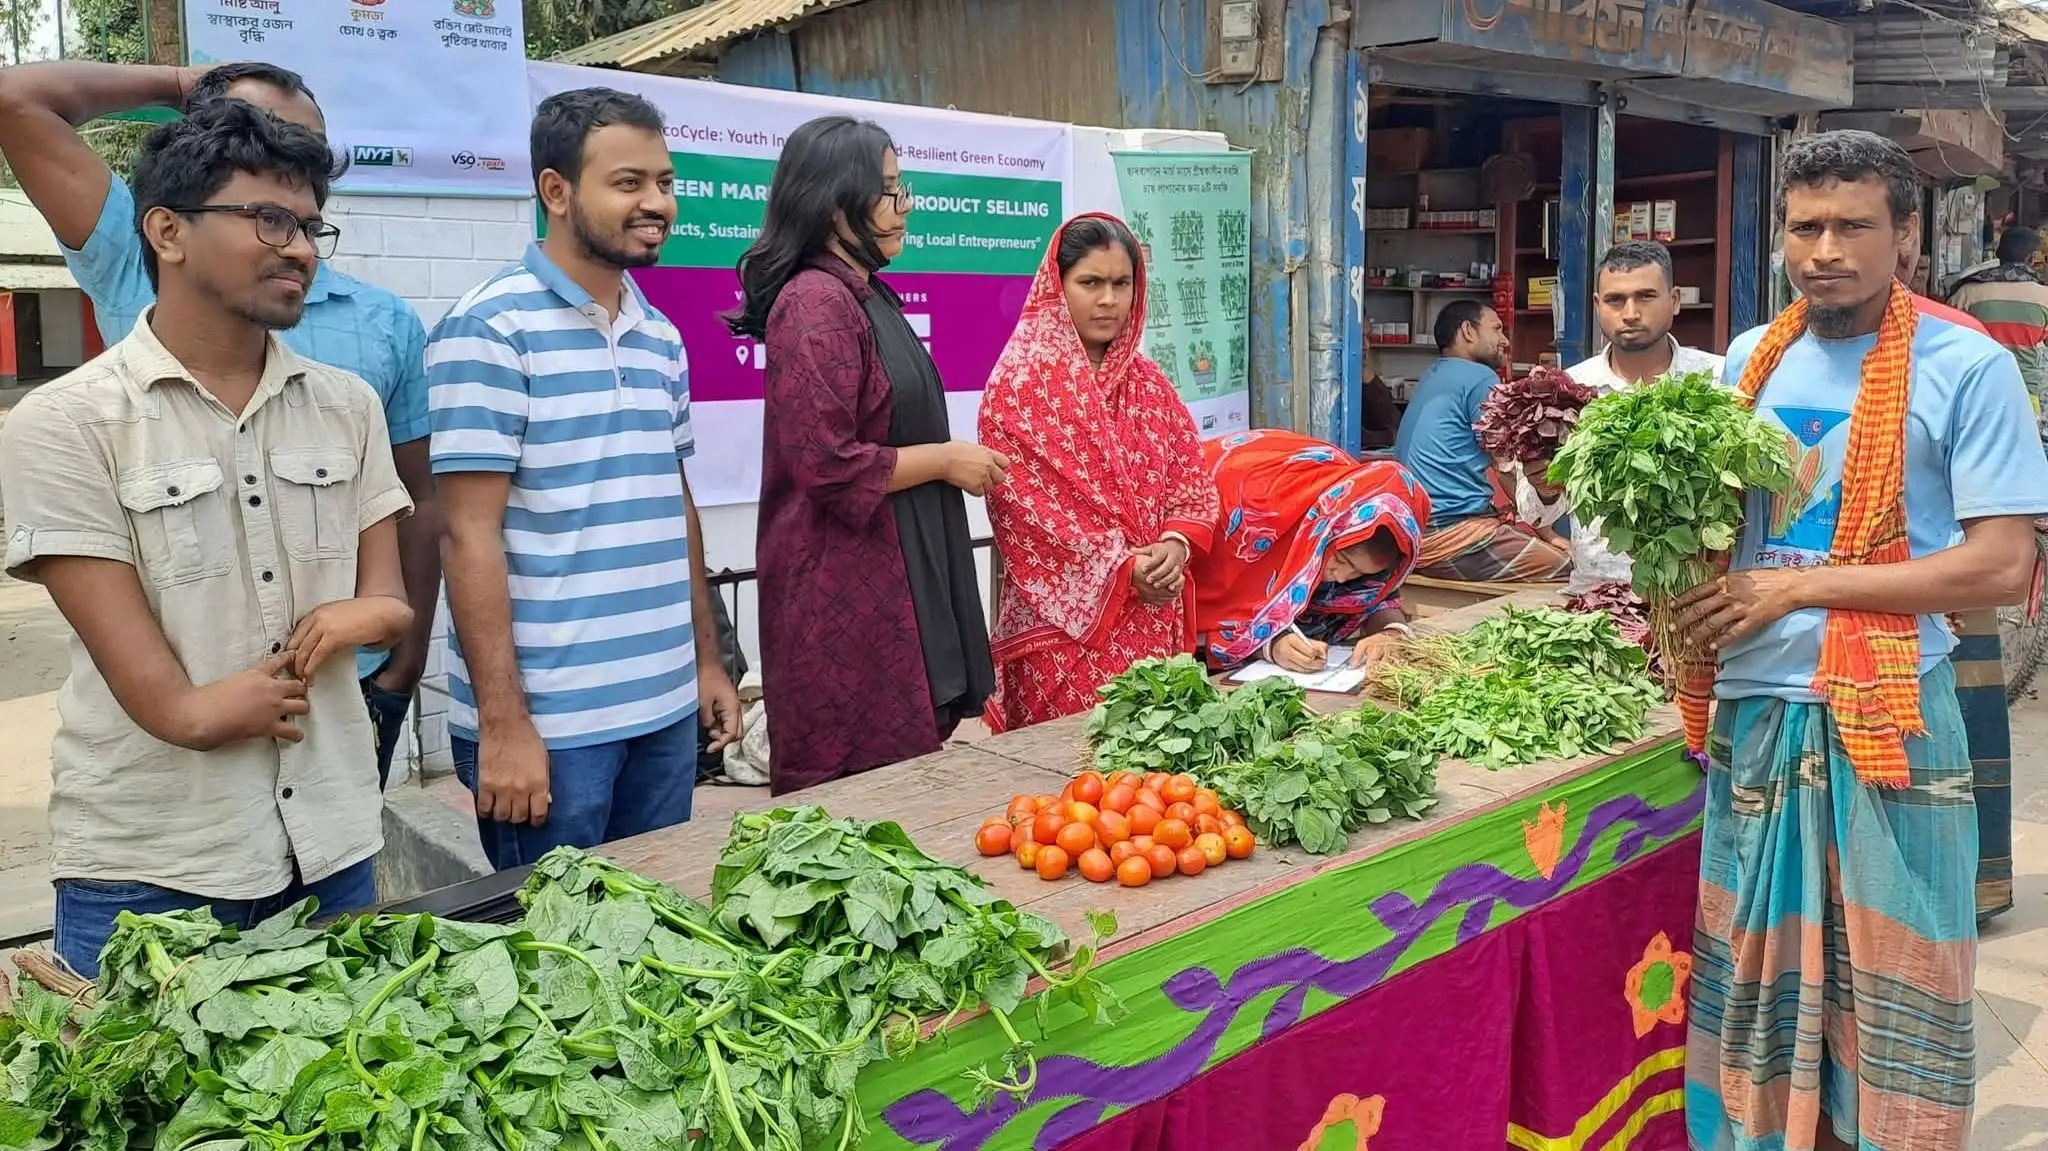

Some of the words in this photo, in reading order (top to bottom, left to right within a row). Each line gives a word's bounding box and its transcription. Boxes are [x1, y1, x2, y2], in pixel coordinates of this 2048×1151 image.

[262, 18, 294, 30] ওজন
[356, 149, 392, 161] NYF
[662, 124, 722, 142] coCycle:
[727, 128, 768, 146] Youth
[772, 133, 788, 147] In
[893, 144, 958, 163] d-Resilient
[960, 150, 995, 165] Green
[997, 153, 1046, 171] Economy
[451, 153, 476, 166] VSO
[672, 178, 714, 198] EEN
[721, 182, 771, 201] MAR
[986, 199, 1049, 217] SELLING
[670, 222, 705, 239] ucts,
[708, 223, 761, 239] Sustain
[903, 231, 924, 248] ing
[926, 233, 956, 246] Local
